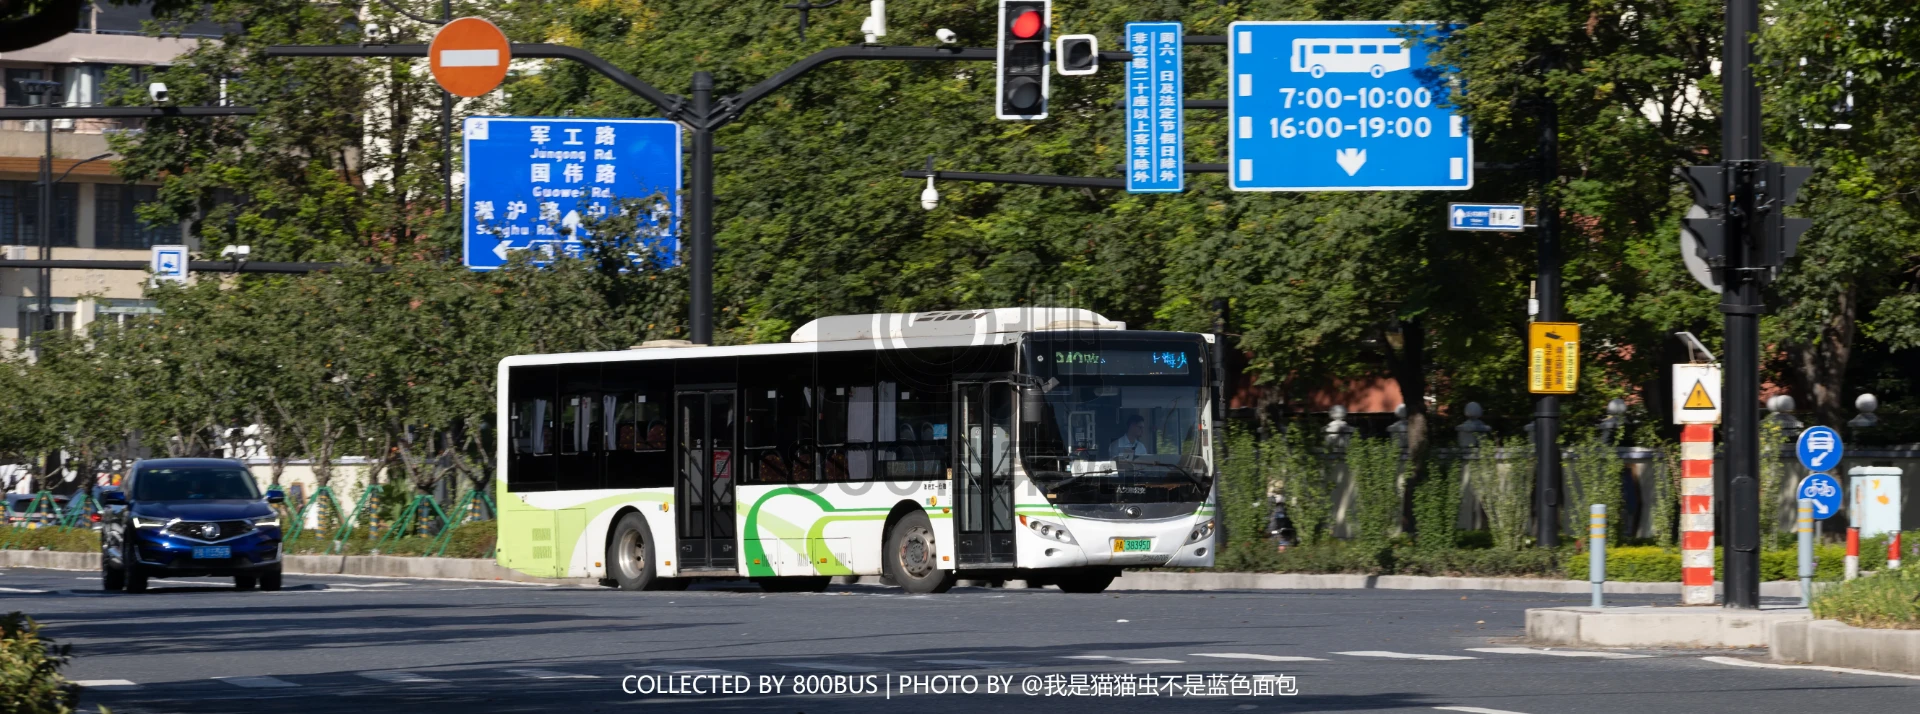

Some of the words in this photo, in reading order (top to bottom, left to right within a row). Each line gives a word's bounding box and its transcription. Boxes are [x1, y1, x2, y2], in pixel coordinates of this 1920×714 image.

[1159, 32, 1176, 182] 周六、日及法定节假日除外
[1279, 87, 1431, 109] 7:00-10:00
[530, 125, 616, 145] 军工路
[1270, 116, 1432, 138] 16:00-19:00
[530, 148, 586, 162] Jungong
[594, 149, 616, 160] Rd.
[531, 163, 616, 183] 国伟路
